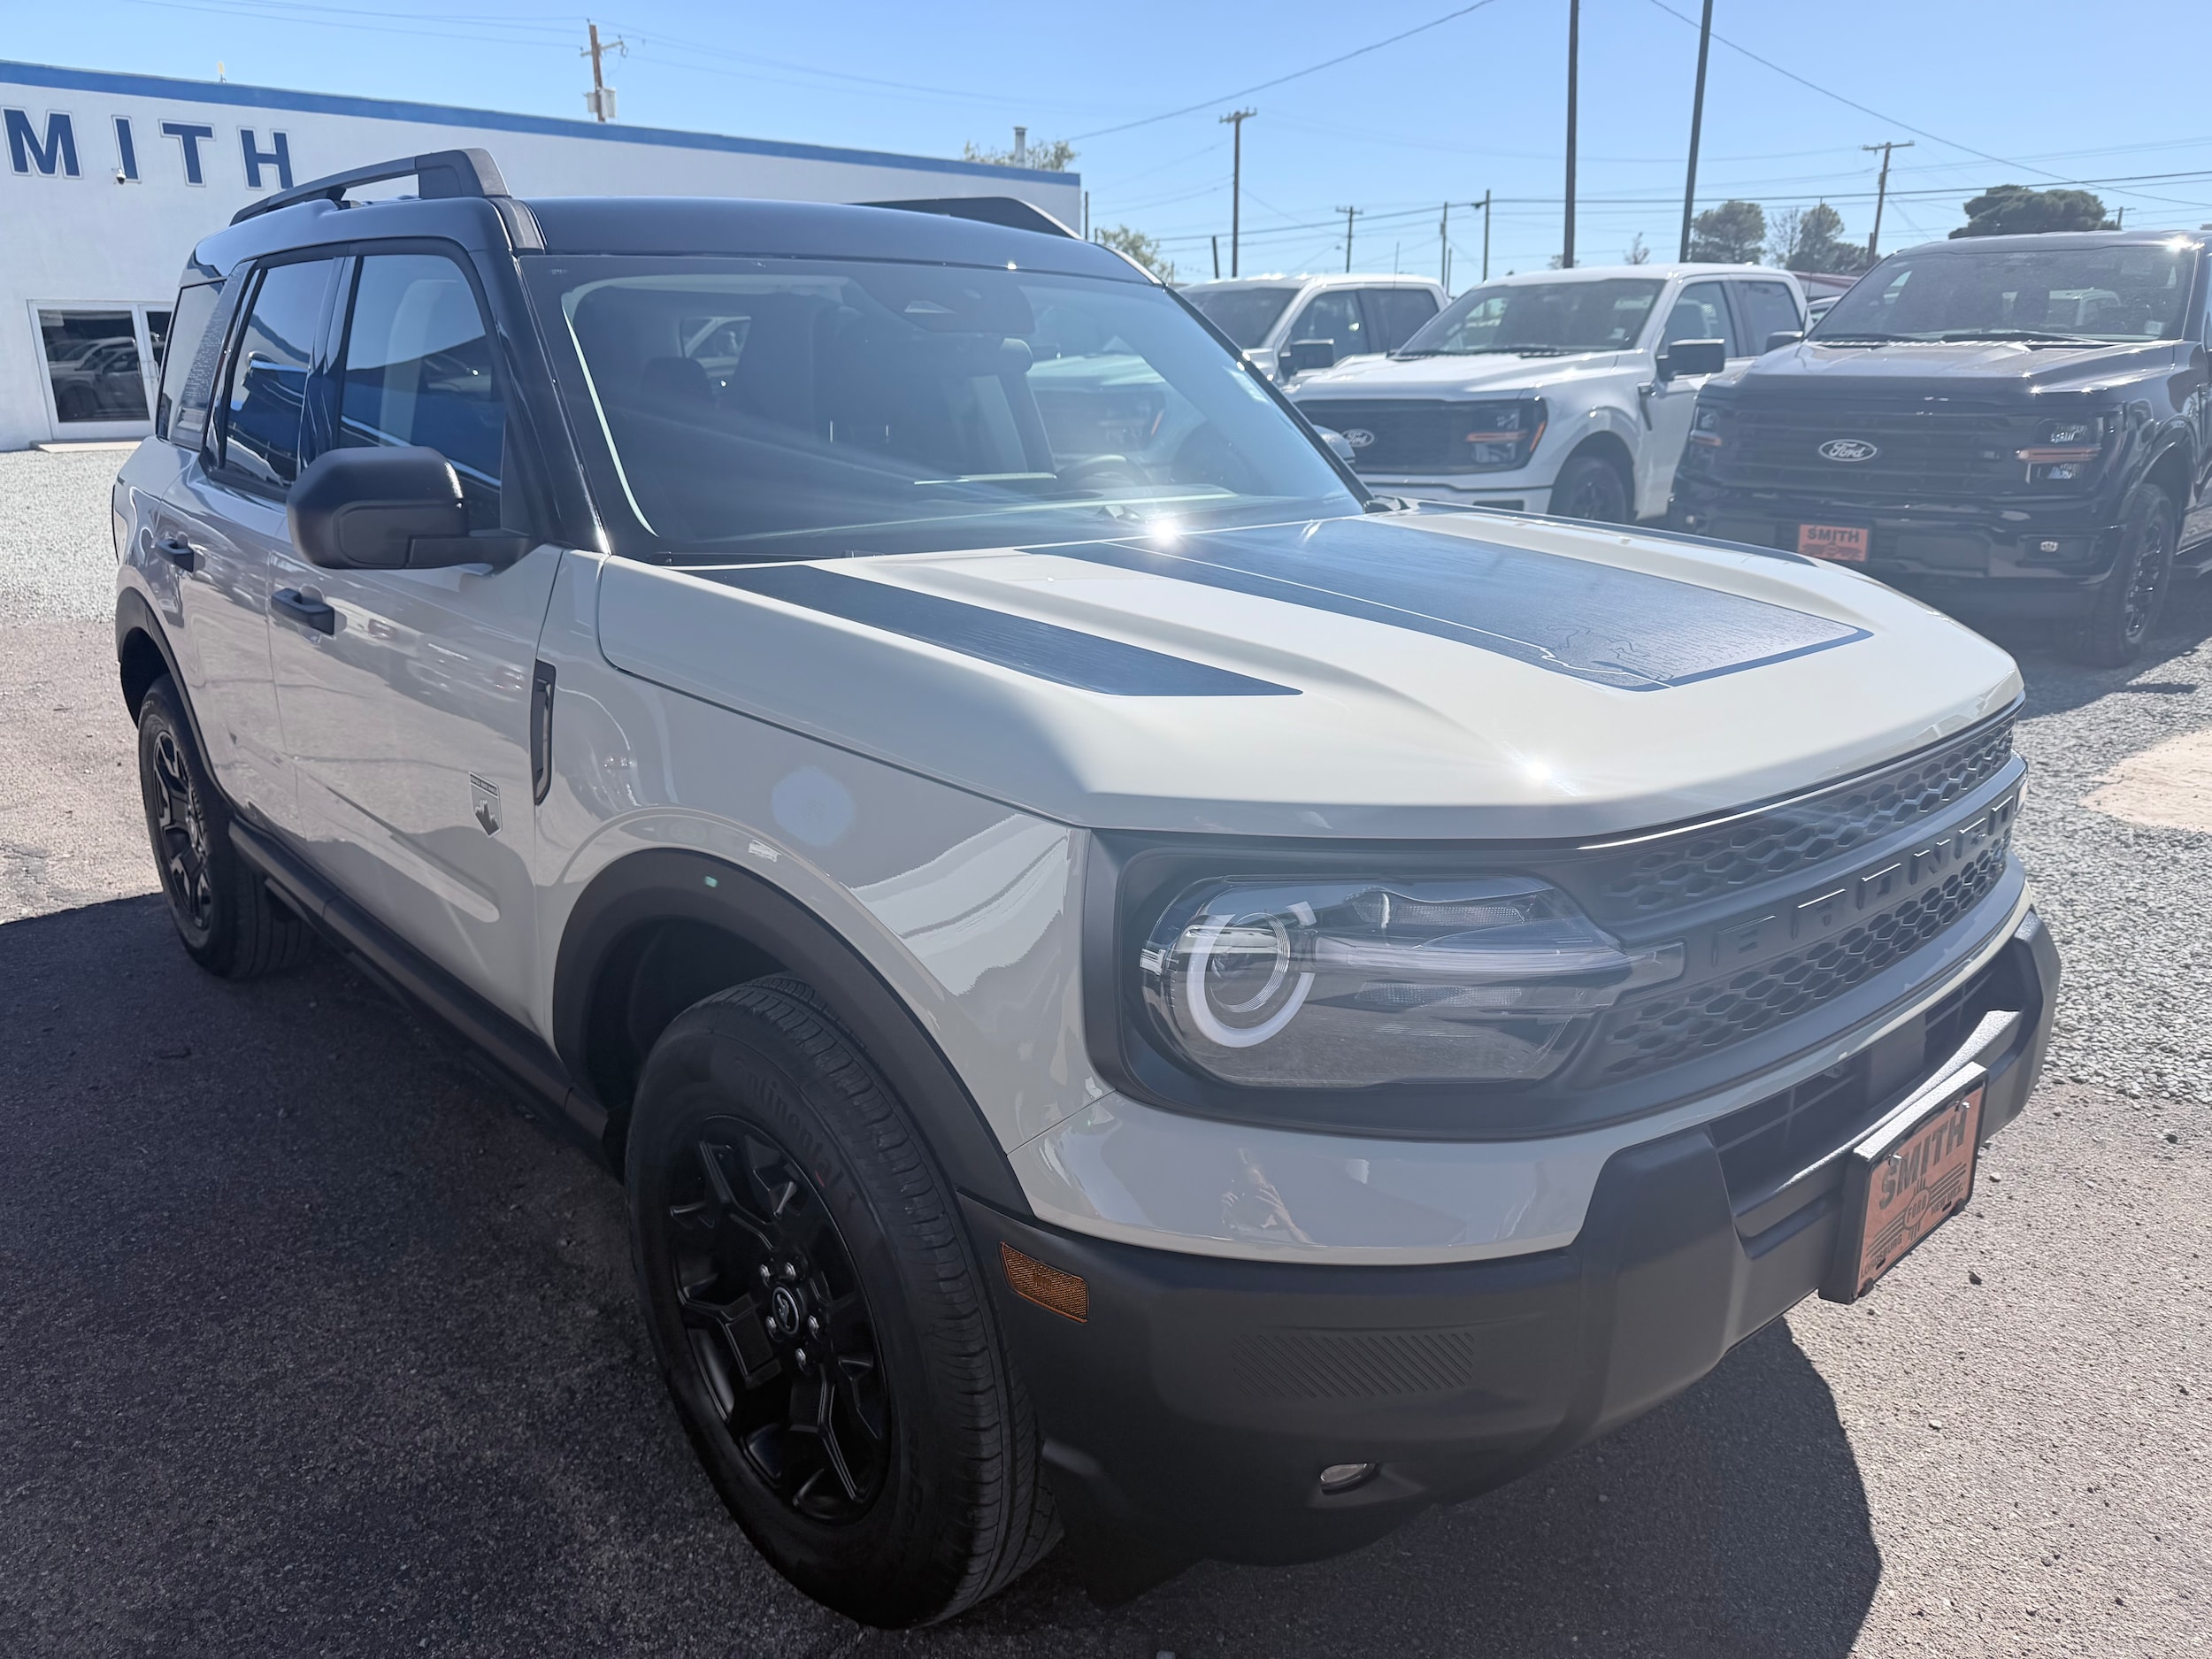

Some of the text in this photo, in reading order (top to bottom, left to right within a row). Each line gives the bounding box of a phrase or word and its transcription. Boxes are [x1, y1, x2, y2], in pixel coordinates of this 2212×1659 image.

[2, 107, 295, 189] MITH
[1807, 527, 1861, 544] SMITH
[1711, 795, 2015, 969] BRONCO
[1878, 1108, 1969, 1210] SMITH
[1906, 1194, 1928, 1224] FORD
